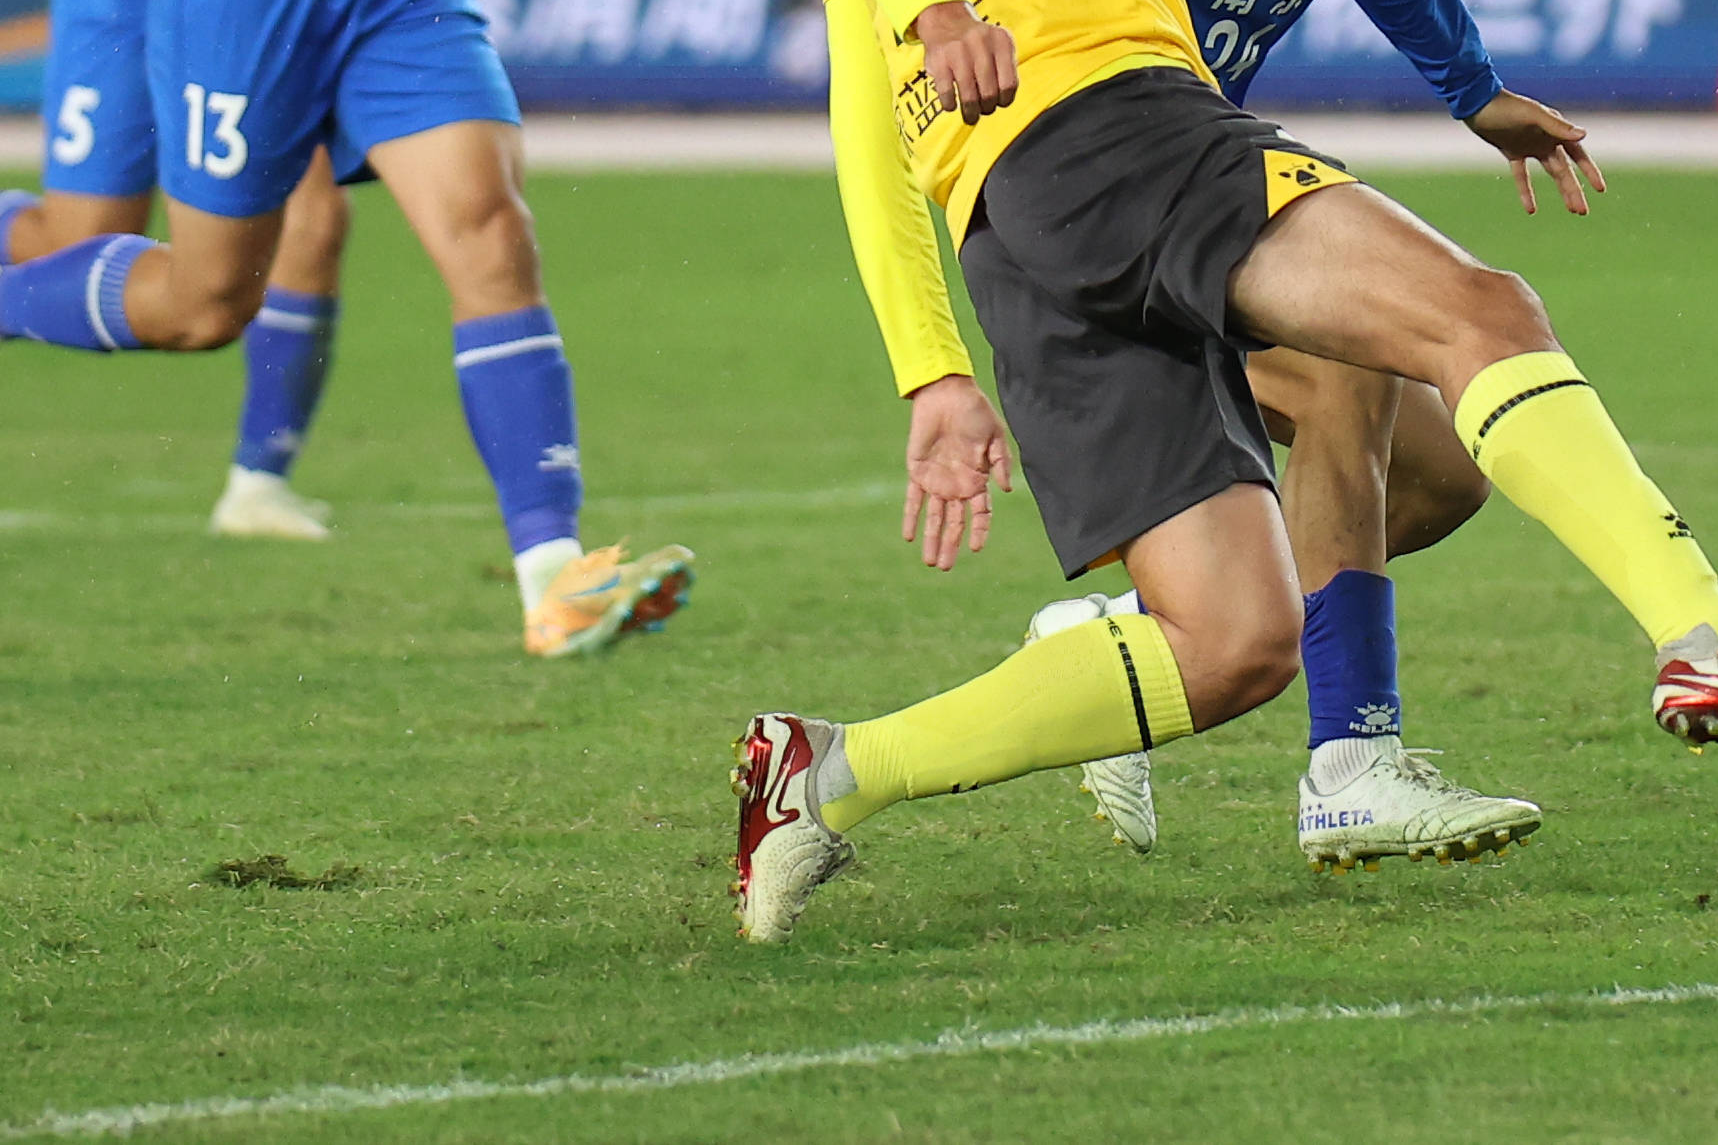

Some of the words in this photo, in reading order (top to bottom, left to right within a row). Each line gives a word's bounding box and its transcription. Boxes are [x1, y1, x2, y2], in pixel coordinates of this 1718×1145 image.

[53, 84, 101, 166] 5
[183, 82, 249, 180] 13
[1349, 721, 1399, 734] KELME
[1299, 809, 1375, 833] ATHLETA
